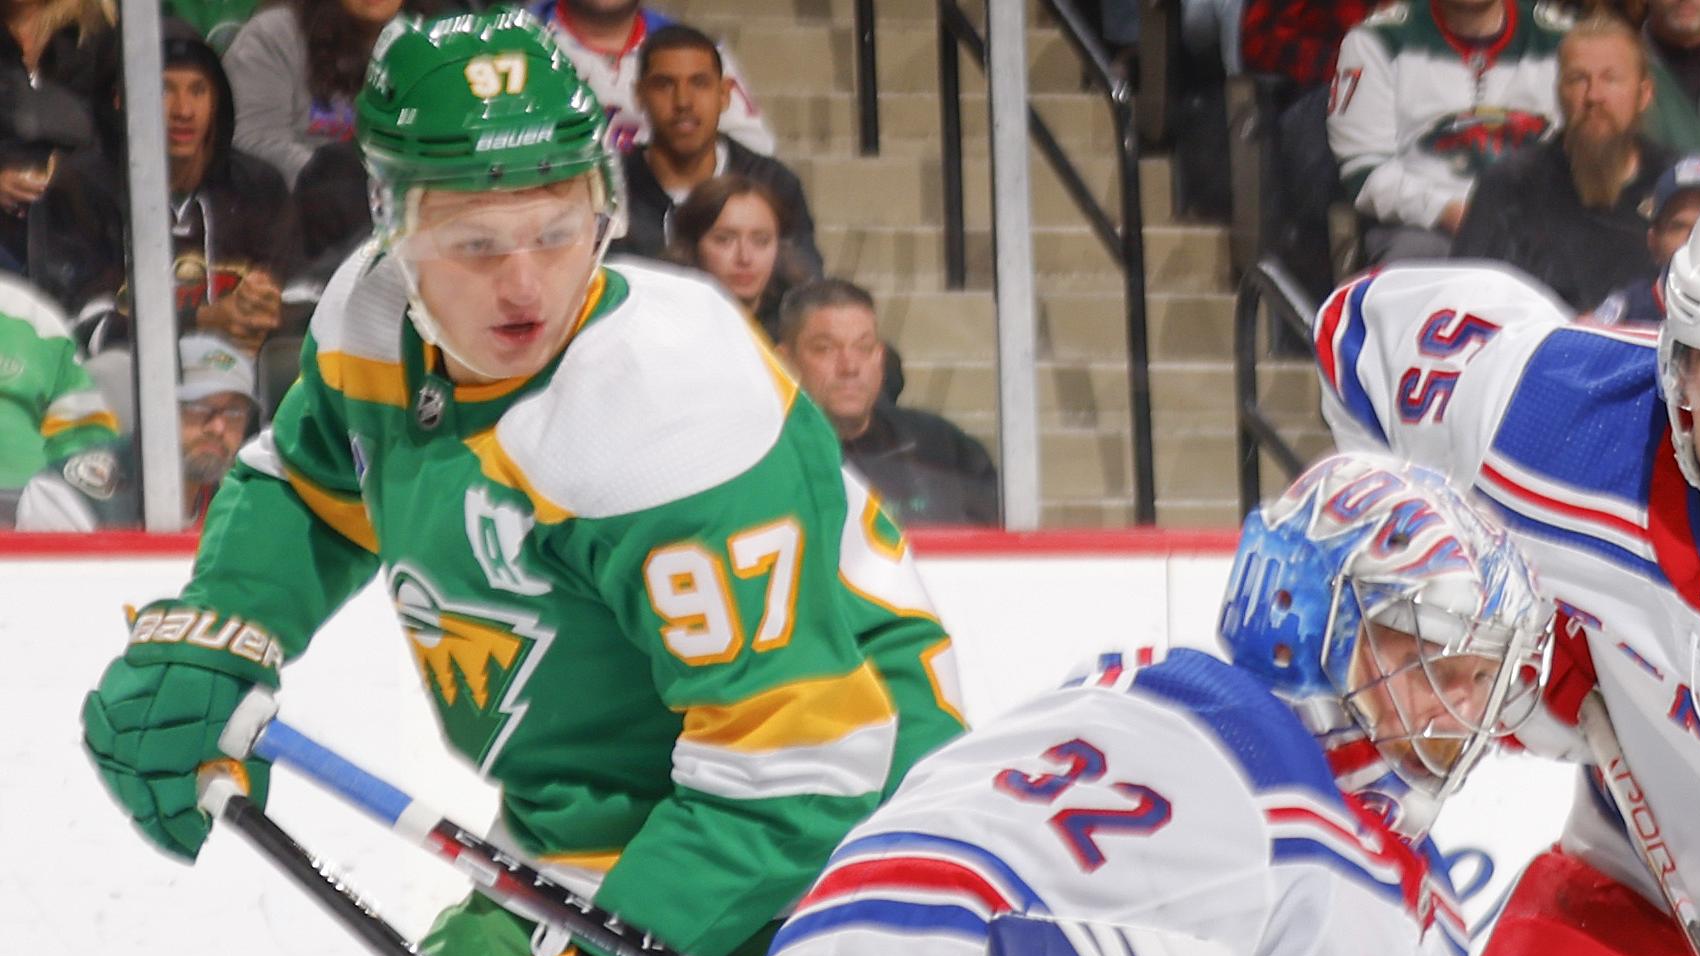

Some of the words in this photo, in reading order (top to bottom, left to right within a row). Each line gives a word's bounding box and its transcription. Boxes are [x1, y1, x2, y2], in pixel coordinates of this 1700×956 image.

[464, 52, 528, 99] 97
[1395, 308, 1504, 426] 55
[641, 516, 804, 667] 97
[992, 737, 1172, 875] 32
